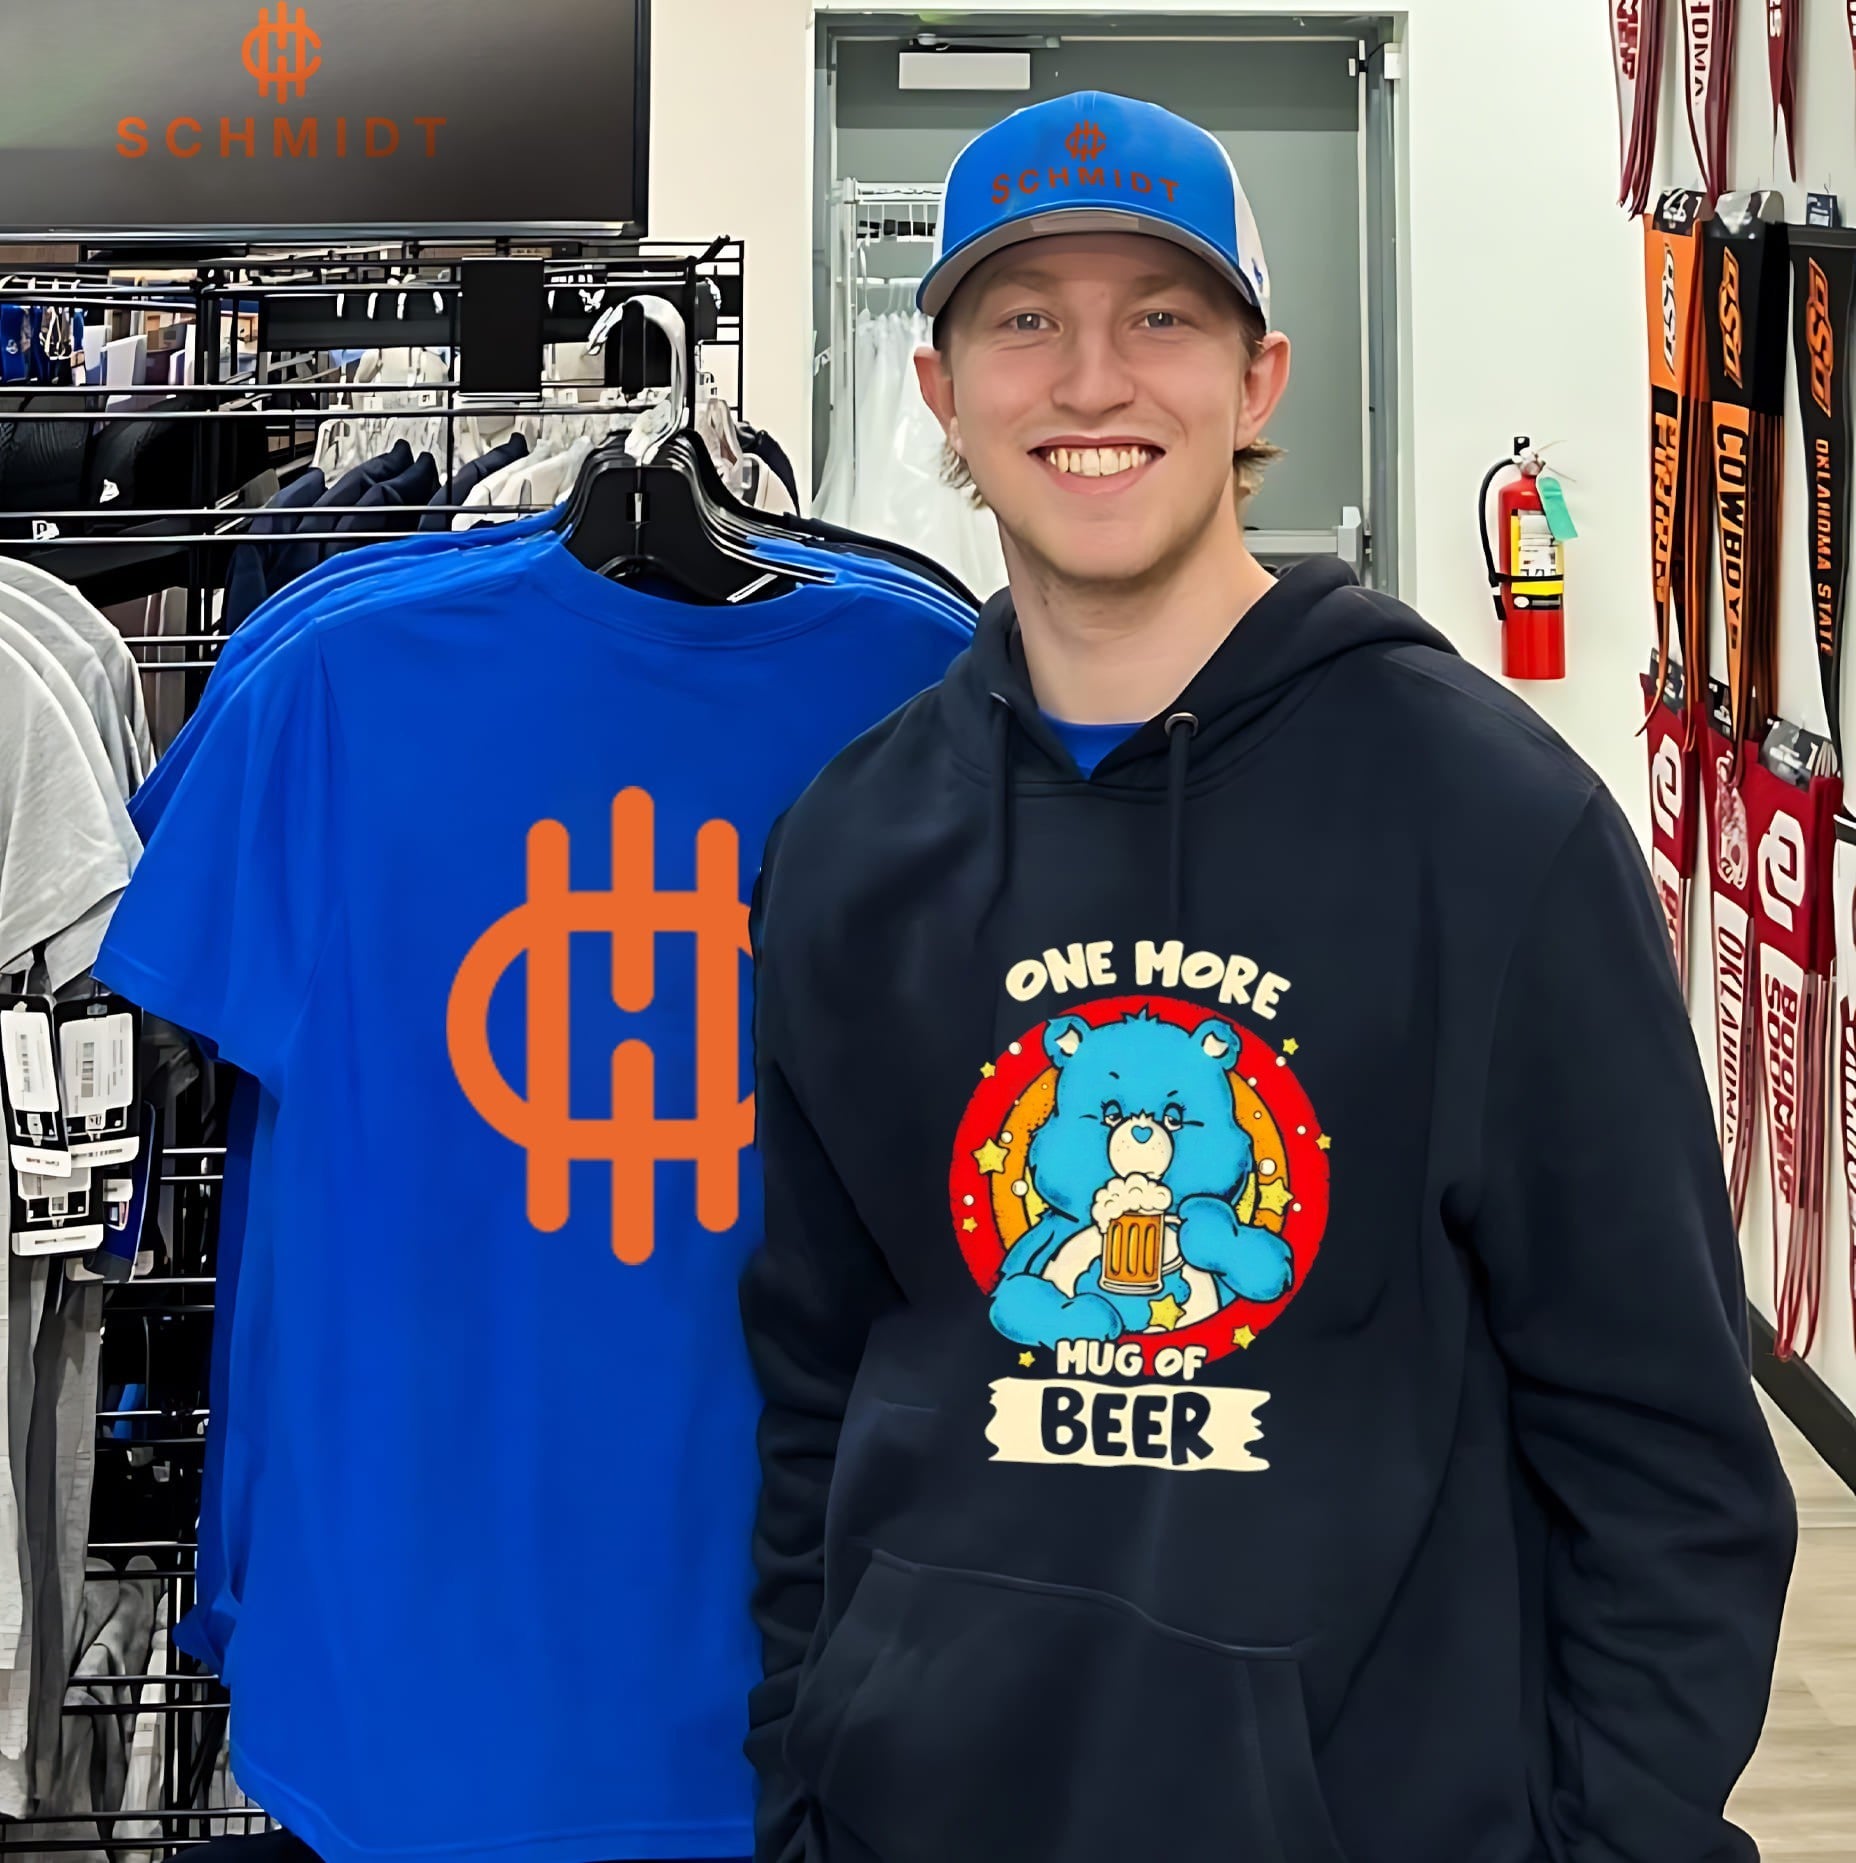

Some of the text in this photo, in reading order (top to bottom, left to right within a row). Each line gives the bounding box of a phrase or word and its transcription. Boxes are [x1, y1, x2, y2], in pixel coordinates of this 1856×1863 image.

[115, 116, 448, 159] SCHMIDT
[991, 166, 1179, 205] SCHMIDT
[1005, 940, 1291, 1020] ONE MORE
[1056, 1339, 1207, 1381] MUG OF
[1040, 1386, 1215, 1466] BEER
